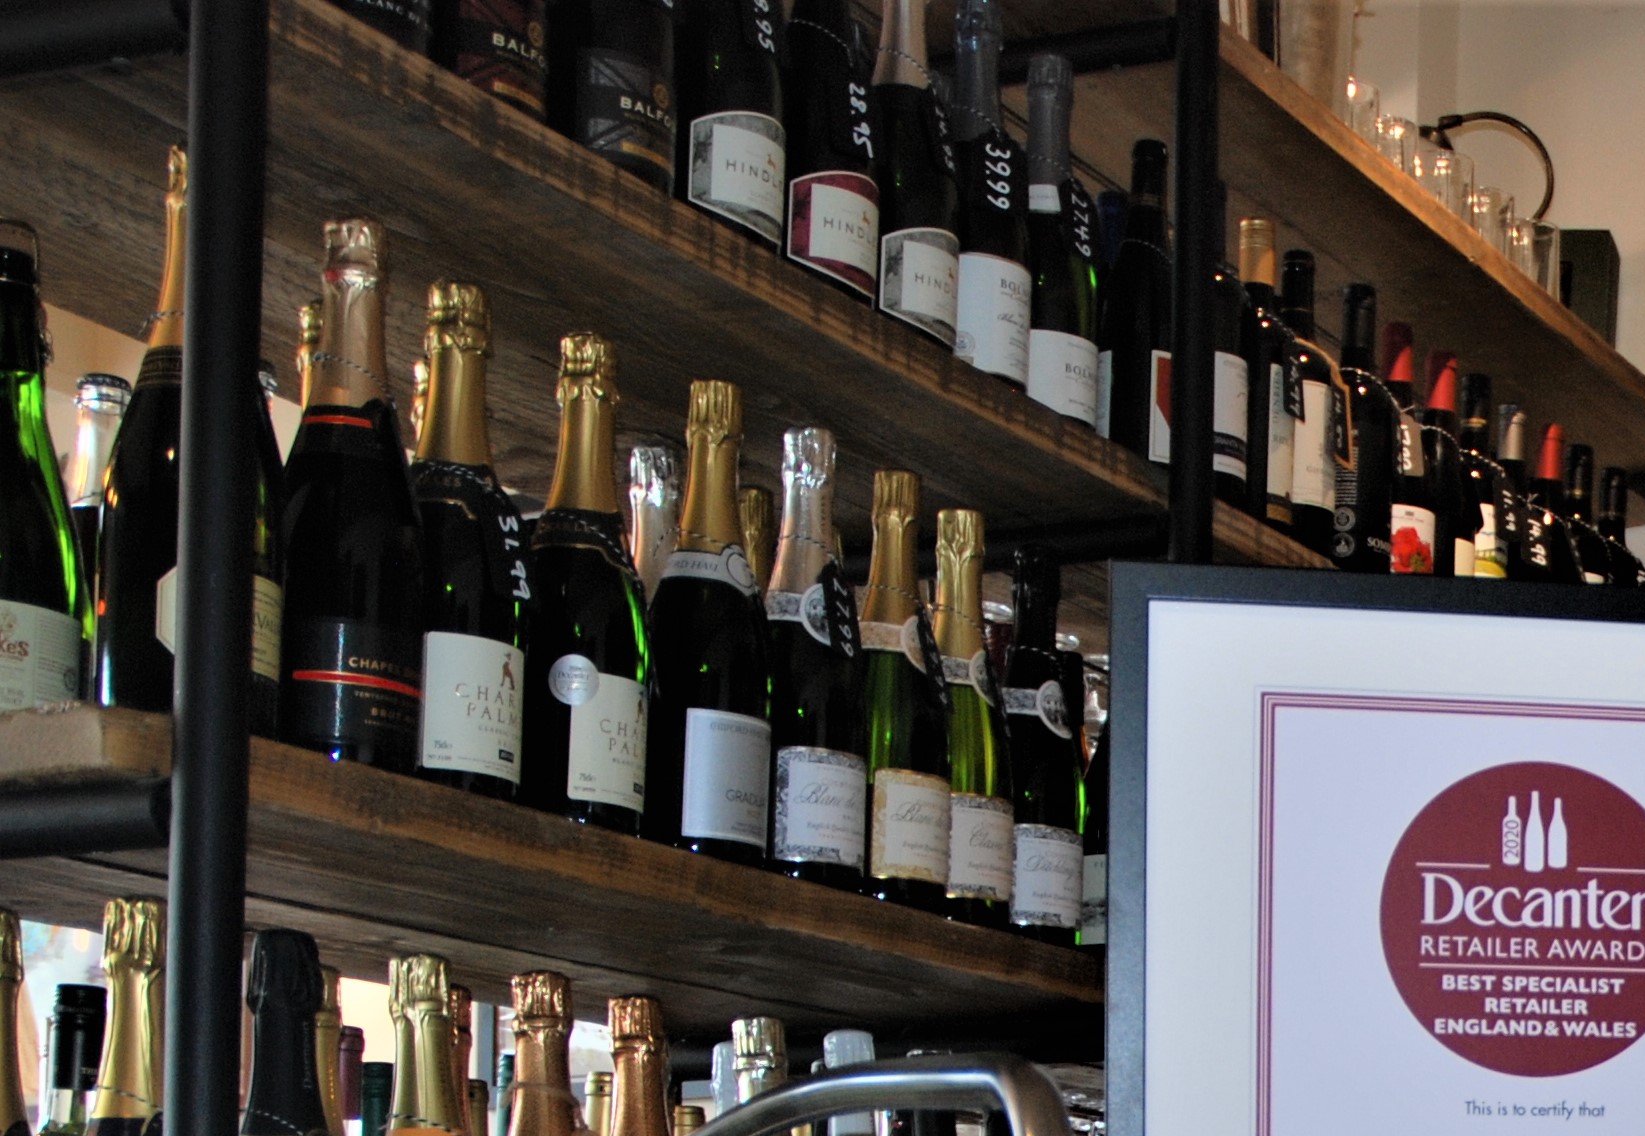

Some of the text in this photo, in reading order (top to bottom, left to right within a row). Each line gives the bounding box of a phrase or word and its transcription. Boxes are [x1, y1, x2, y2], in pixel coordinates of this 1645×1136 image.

[847, 82, 873, 159] 28.95
[984, 142, 1013, 211] 39.99
[1503, 818, 1520, 859] 2020
[1420, 935, 1540, 959] RETAILER
[1441, 974, 1625, 995] BEST SPECIALIST
[1484, 997, 1588, 1015] RETAILER
[1464, 1100, 1605, 1121] This is to certify that
